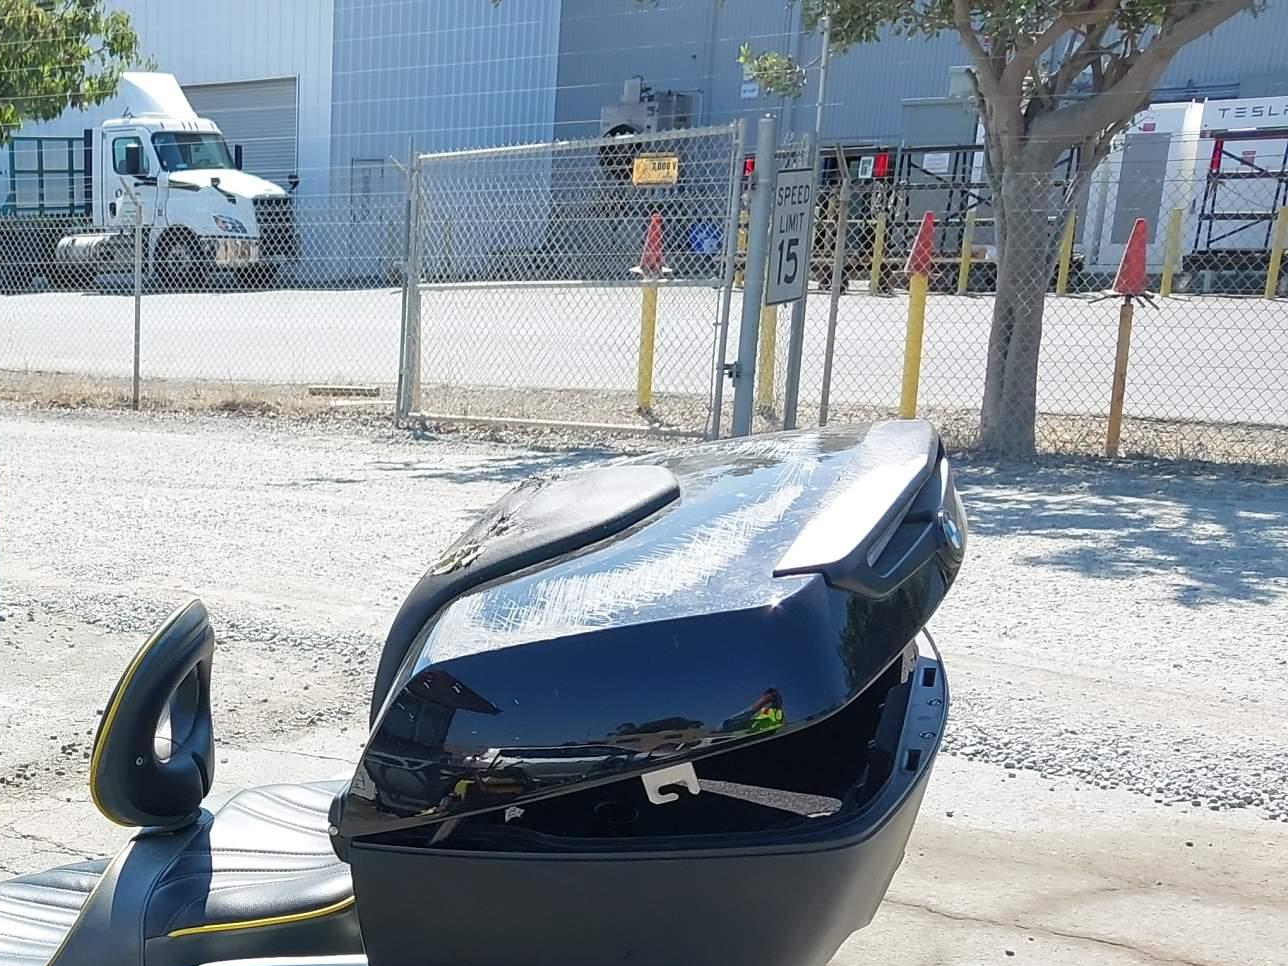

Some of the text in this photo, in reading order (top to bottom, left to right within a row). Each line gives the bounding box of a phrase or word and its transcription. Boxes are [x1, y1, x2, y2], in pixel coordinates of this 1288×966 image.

[777, 184, 811, 207] SPEED
[779, 212, 805, 234] LIMIT
[777, 238, 799, 286] 15
